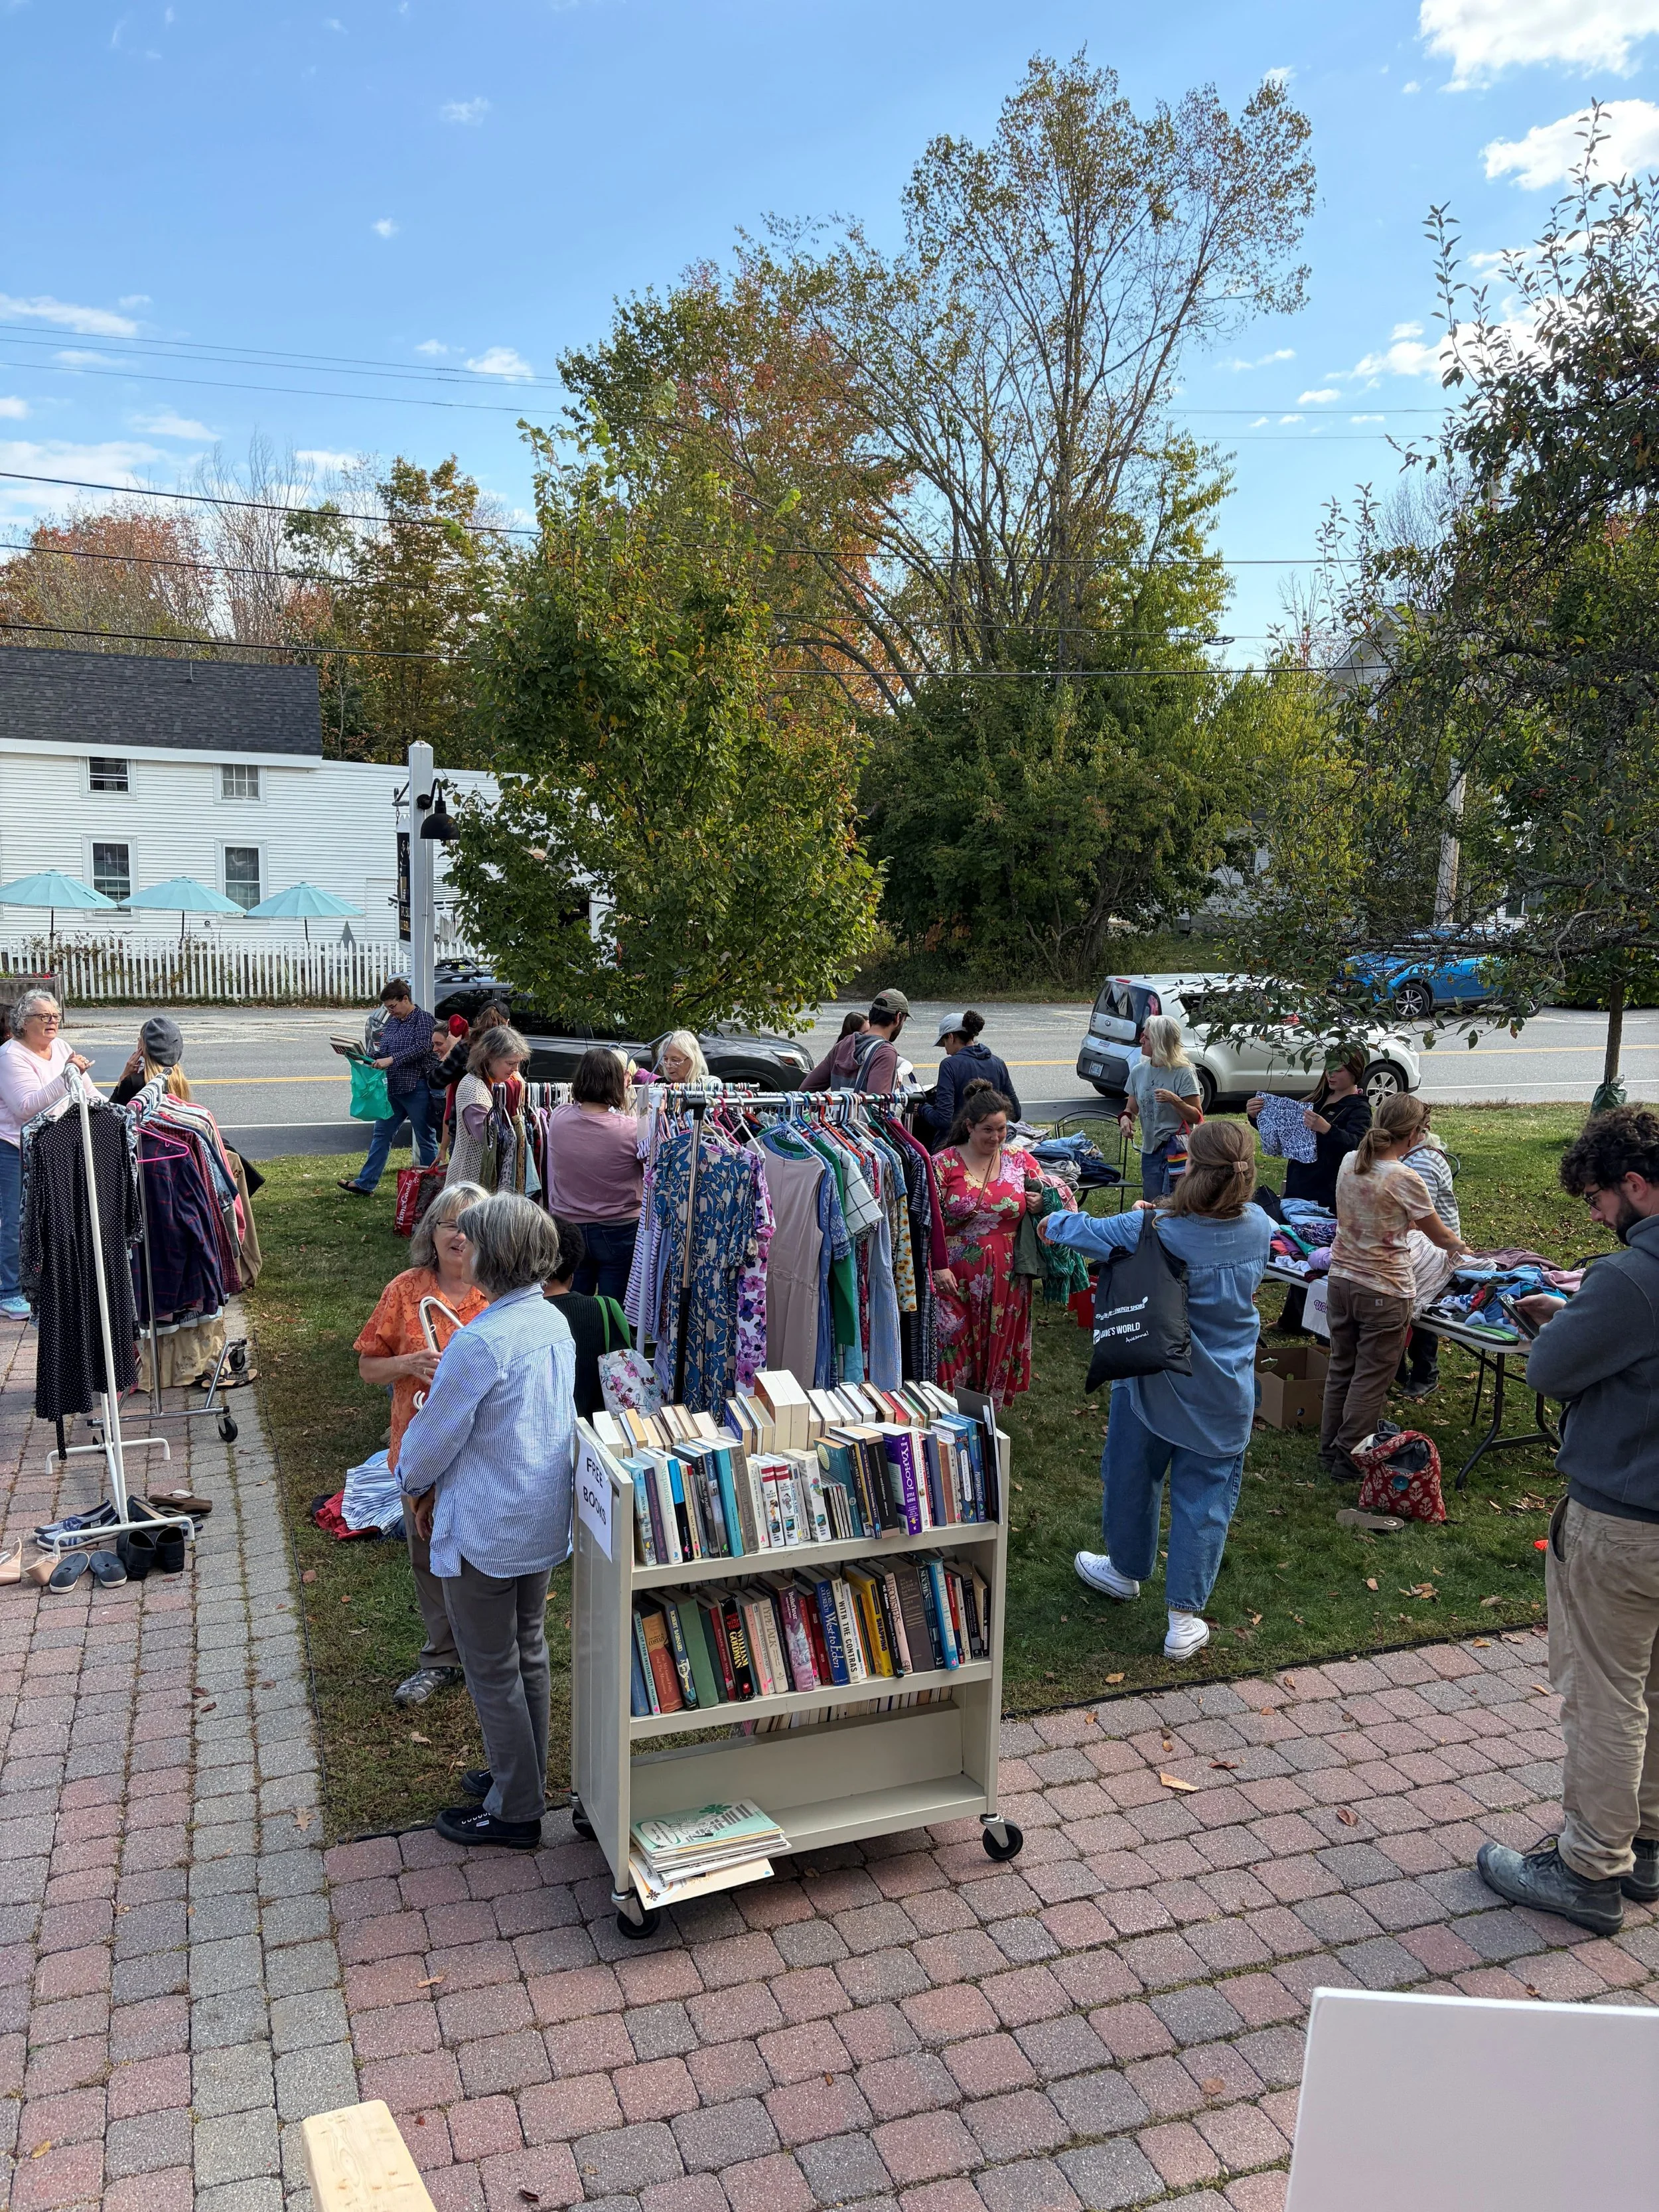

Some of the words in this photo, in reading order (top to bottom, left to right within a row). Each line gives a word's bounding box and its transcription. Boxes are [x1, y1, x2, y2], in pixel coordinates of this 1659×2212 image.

[397, 1179, 412, 1225] HomeGoods
[1116, 1322, 1141, 1335] WORLD
[586, 1457, 603, 1489] FREE
[900, 1447, 914, 1491] YAHOO!
[583, 1485, 607, 1526] BOOKS
[658, 1465, 674, 1516] Stepmonster
[887, 1585, 901, 1623] FOOTSTEPS
[921, 1582, 930, 1598] MEN
[762, 1606, 774, 1626] TYPE
[787, 1591, 798, 1620] Bellefleur
[837, 1600, 847, 1619] WITH
[669, 1610, 678, 1629] ROBERT
[674, 1629, 683, 1652] BARNARD
[766, 1627, 778, 1647] TALK
[824, 1611, 839, 1635] West
[842, 1622, 851, 1637] THE
[875, 1617, 887, 1651] SNAPPING
[728, 1631, 743, 1668] GOLDMAN
[736, 1629, 749, 1666] WILLIAM
[829, 1635, 837, 1645] to
[845, 1638, 857, 1672] CONTRAS
[830, 1644, 845, 1668] Eden
[644, 1657, 653, 1686] INVISIBILITY
